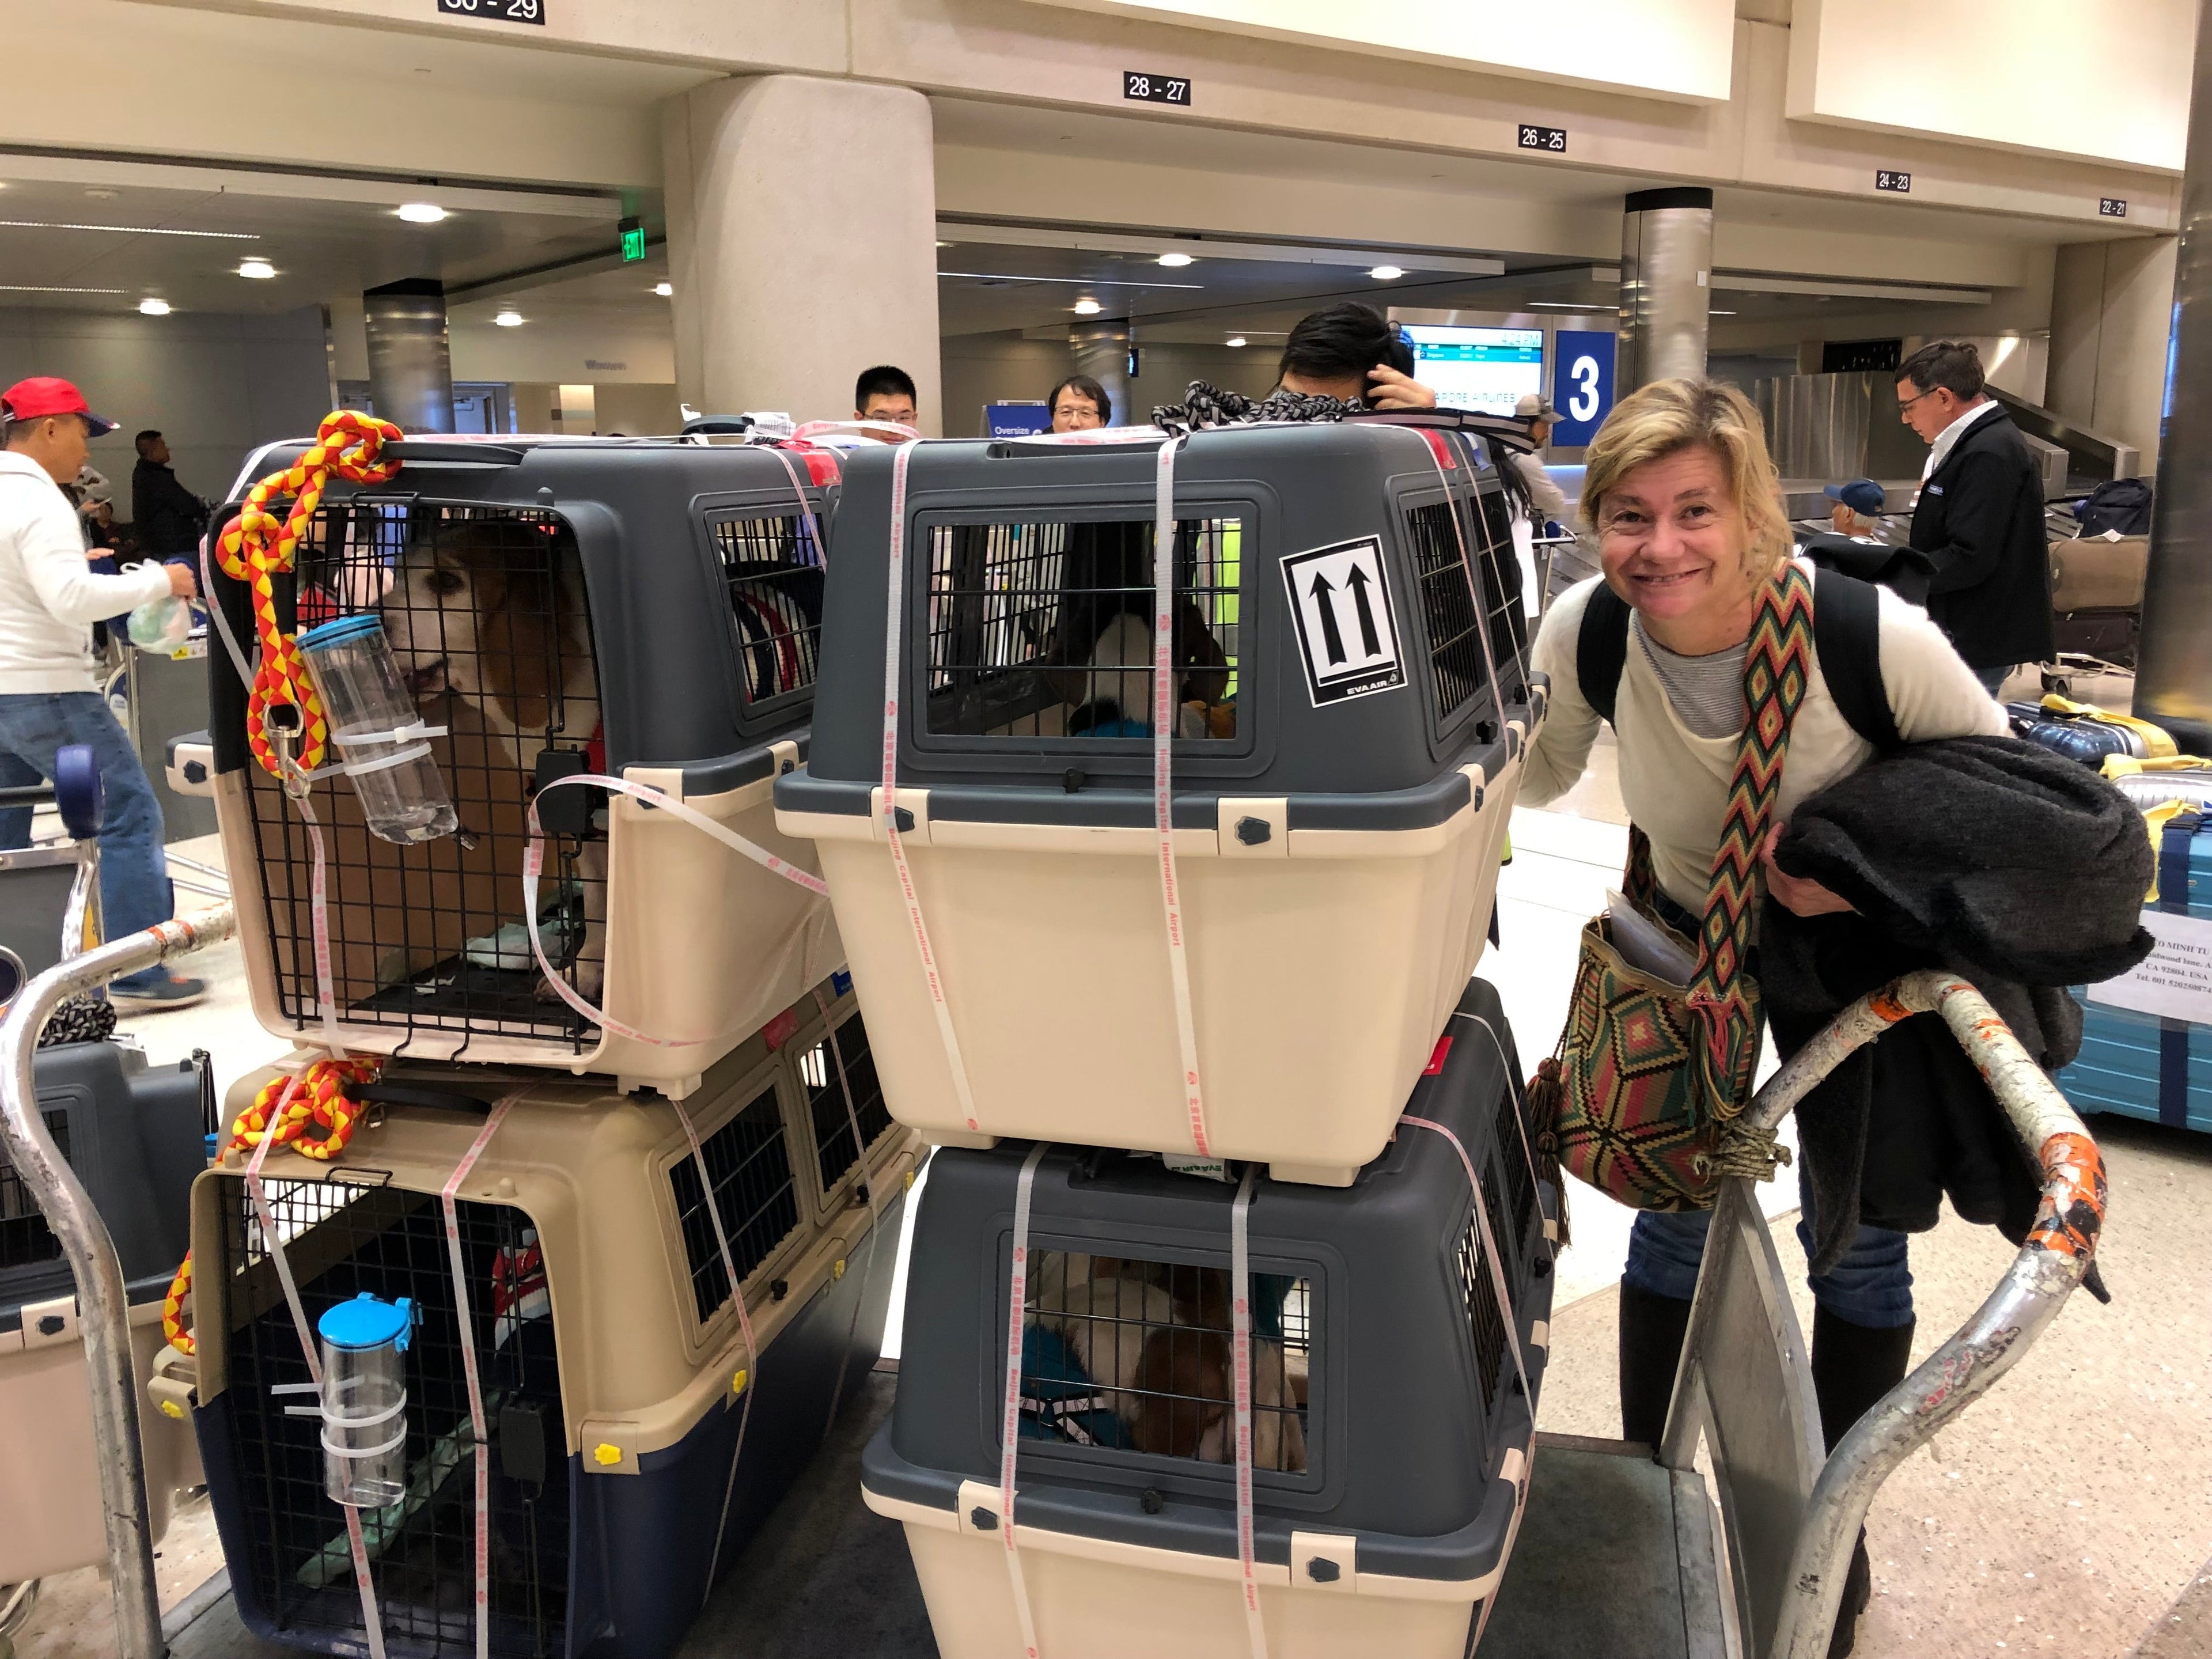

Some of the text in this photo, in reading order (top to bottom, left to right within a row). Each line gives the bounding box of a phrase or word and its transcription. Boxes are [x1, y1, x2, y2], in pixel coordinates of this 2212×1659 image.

[507, 0, 537, 18] 29
[1129, 76, 1150, 97] 28
[1166, 81, 1186, 100] 27
[1522, 128, 1537, 146] 26
[1549, 131, 1563, 149] 25
[1879, 173, 1889, 187] 24
[1897, 175, 1908, 190] 23
[2102, 200, 2112, 213] 22
[2116, 202, 2125, 215] 21
[1569, 355, 1600, 422] 3
[994, 426, 1030, 435] Oversize
[628, 785, 661, 802] Airport
[1159, 792, 1169, 833] Capital
[1162, 843, 1176, 906] International
[888, 828, 942, 1002] Beijing Capital International Airport
[1170, 912, 1180, 946] Airport
[2166, 942, 2194, 953] MINH
[2197, 947, 2210, 956] TU
[2146, 963, 2158, 971] CA
[2190, 971, 2208, 980] USA
[1004, 1369, 1018, 1551] Beijing Capital International Airport
[1238, 1426, 1257, 1612] Beijing Capital International Airport
